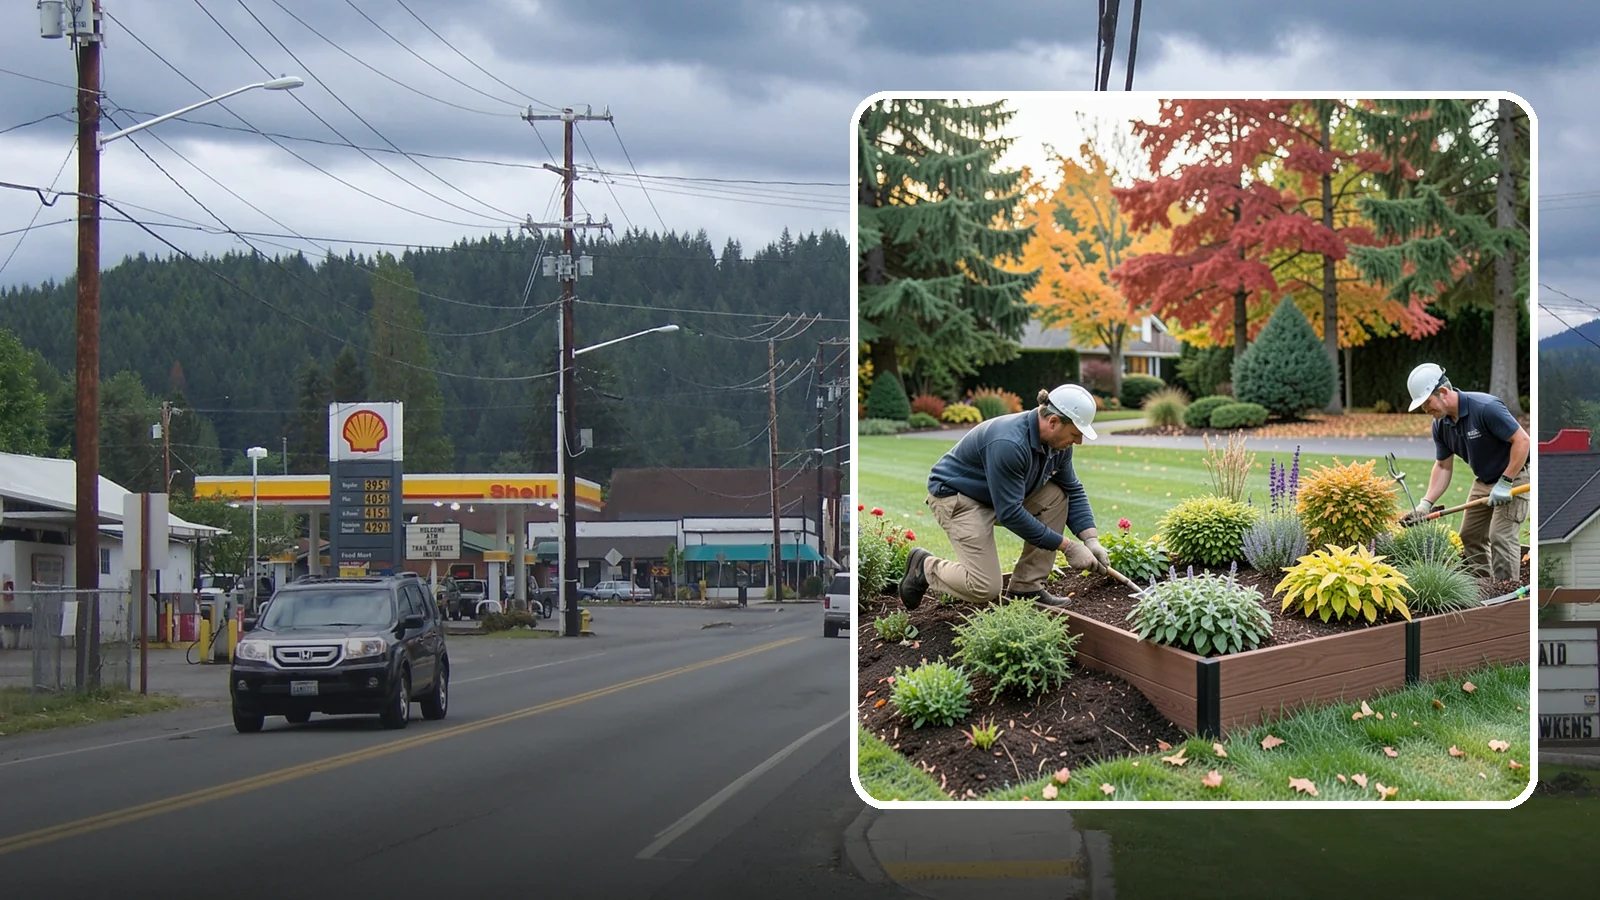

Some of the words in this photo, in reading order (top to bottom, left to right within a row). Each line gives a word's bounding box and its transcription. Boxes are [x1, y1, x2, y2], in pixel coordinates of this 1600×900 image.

[366, 480, 383, 490] 395
[490, 484, 547, 499] Shell
[366, 494, 383, 504] 405
[366, 508, 383, 518] 415
[366, 522, 383, 532] 429
